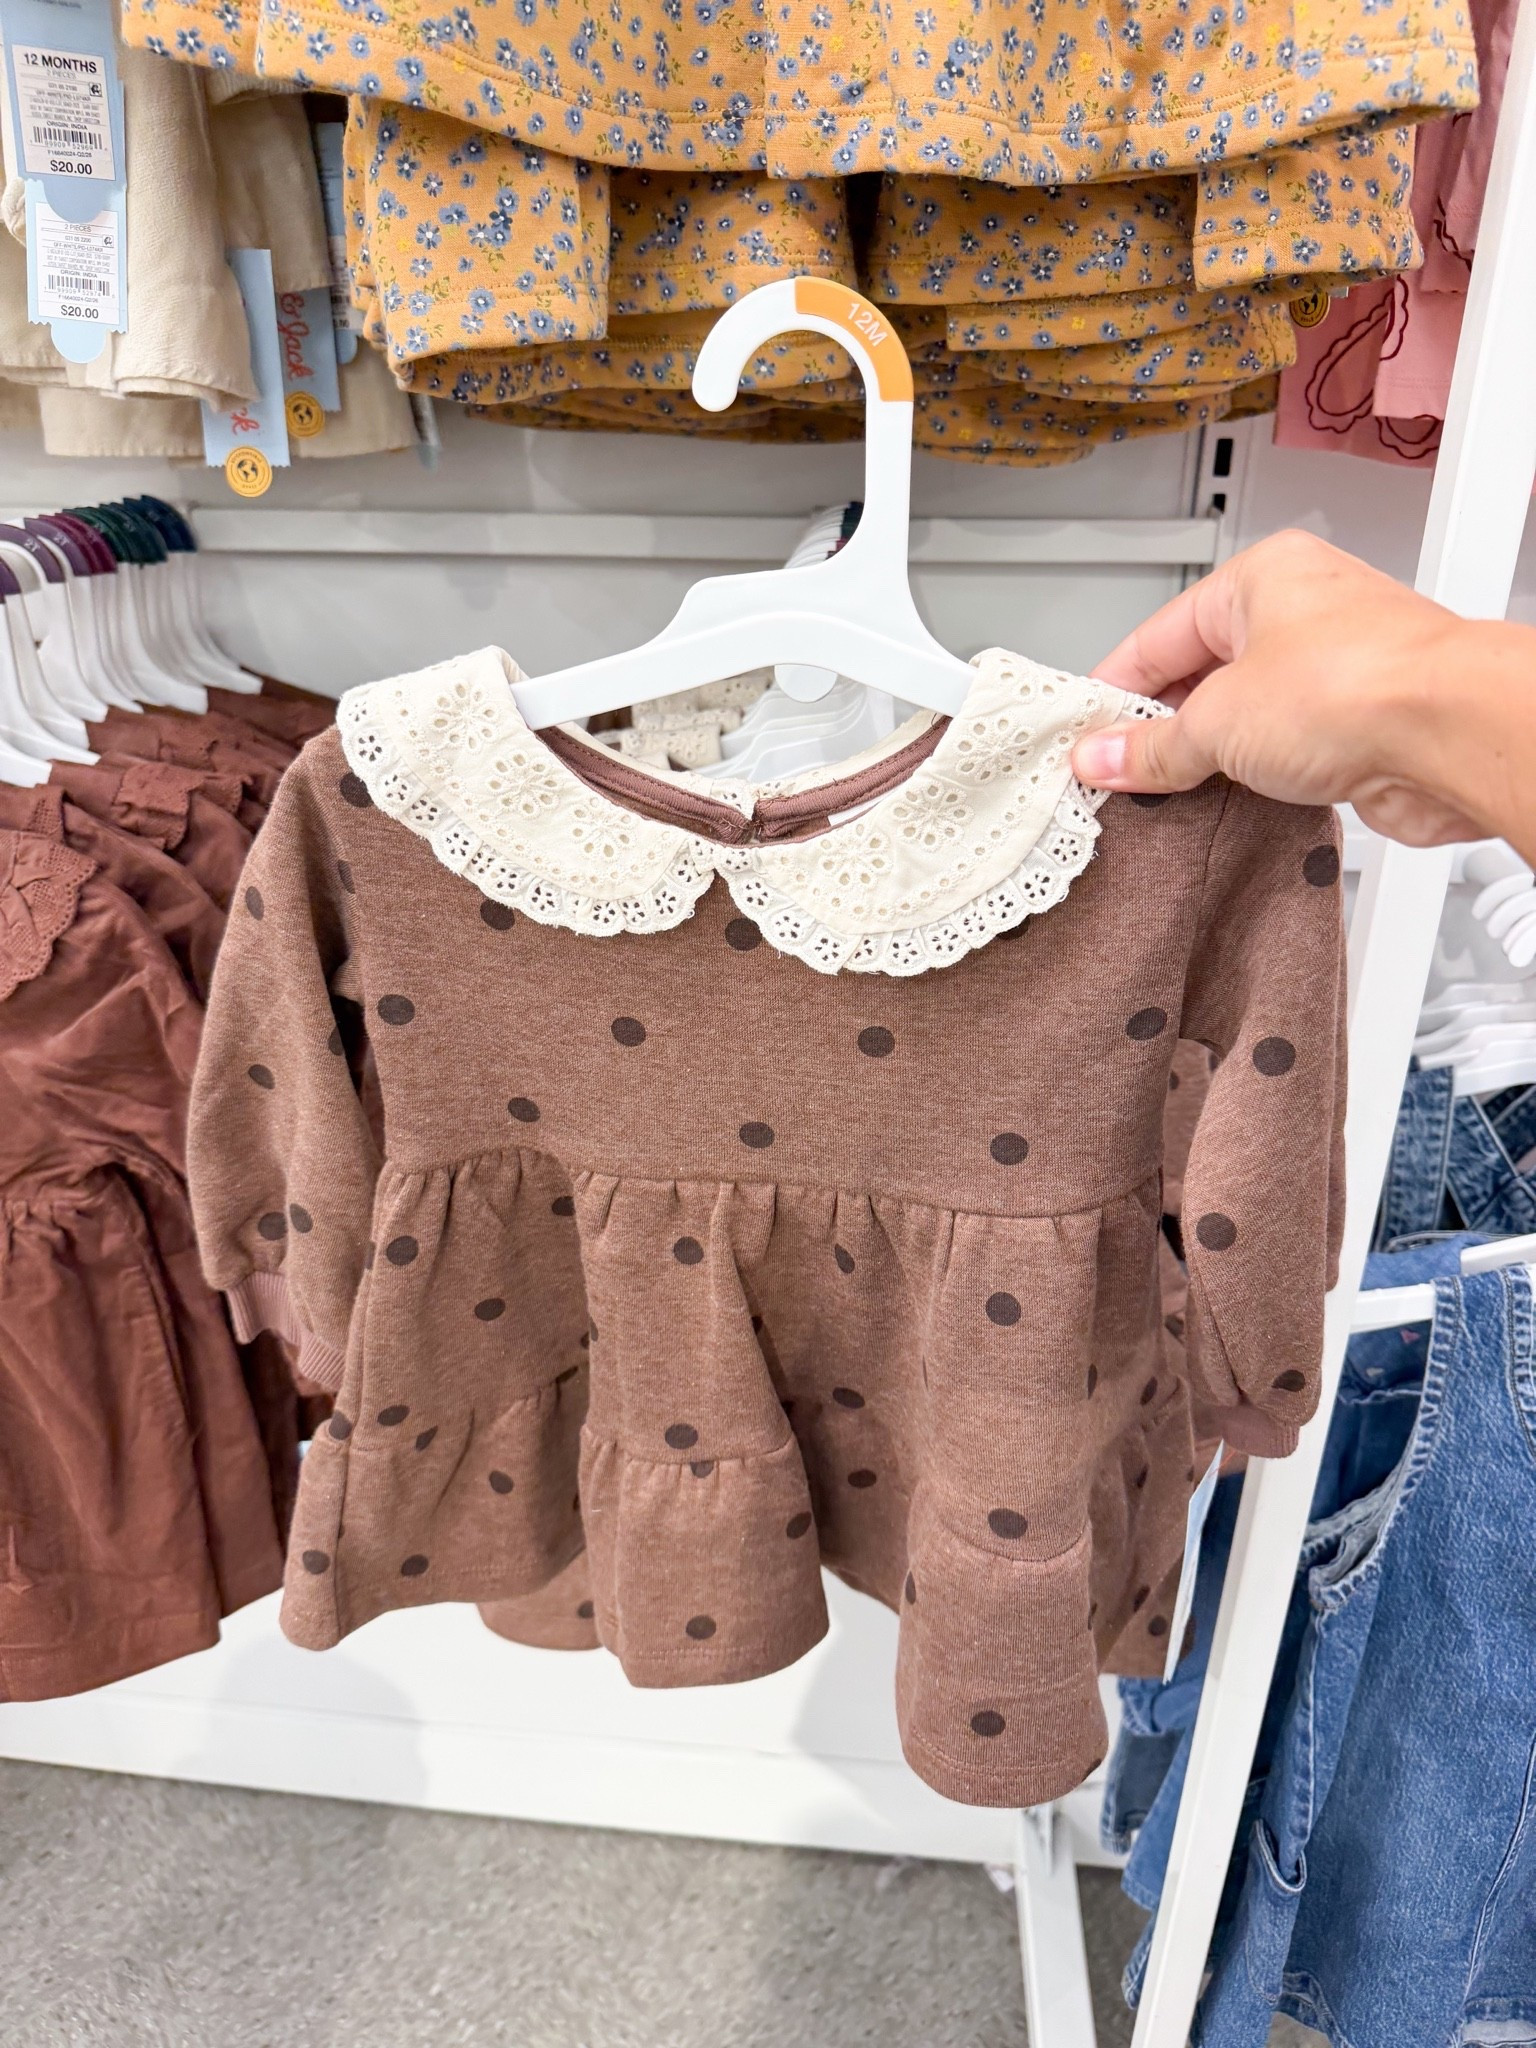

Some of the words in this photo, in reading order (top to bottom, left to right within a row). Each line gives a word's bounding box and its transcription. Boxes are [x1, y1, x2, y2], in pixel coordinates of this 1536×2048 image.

[24, 53, 39, 66] 12
[41, 55, 97, 73] MONTHS
[46, 120, 70, 129] ORIGIN:
[71, 122, 88, 131] INDIA
[50, 159, 93, 175] $20.00
[69, 224, 92, 233] PIECES
[60, 269, 81, 277] ORIGIN:
[82, 271, 98, 279] INDIA
[60, 304, 99, 319] $20.00
[847, 303, 888, 347] 12M
[276, 320, 315, 382] Jack
[24, 537, 41, 553] 2T
